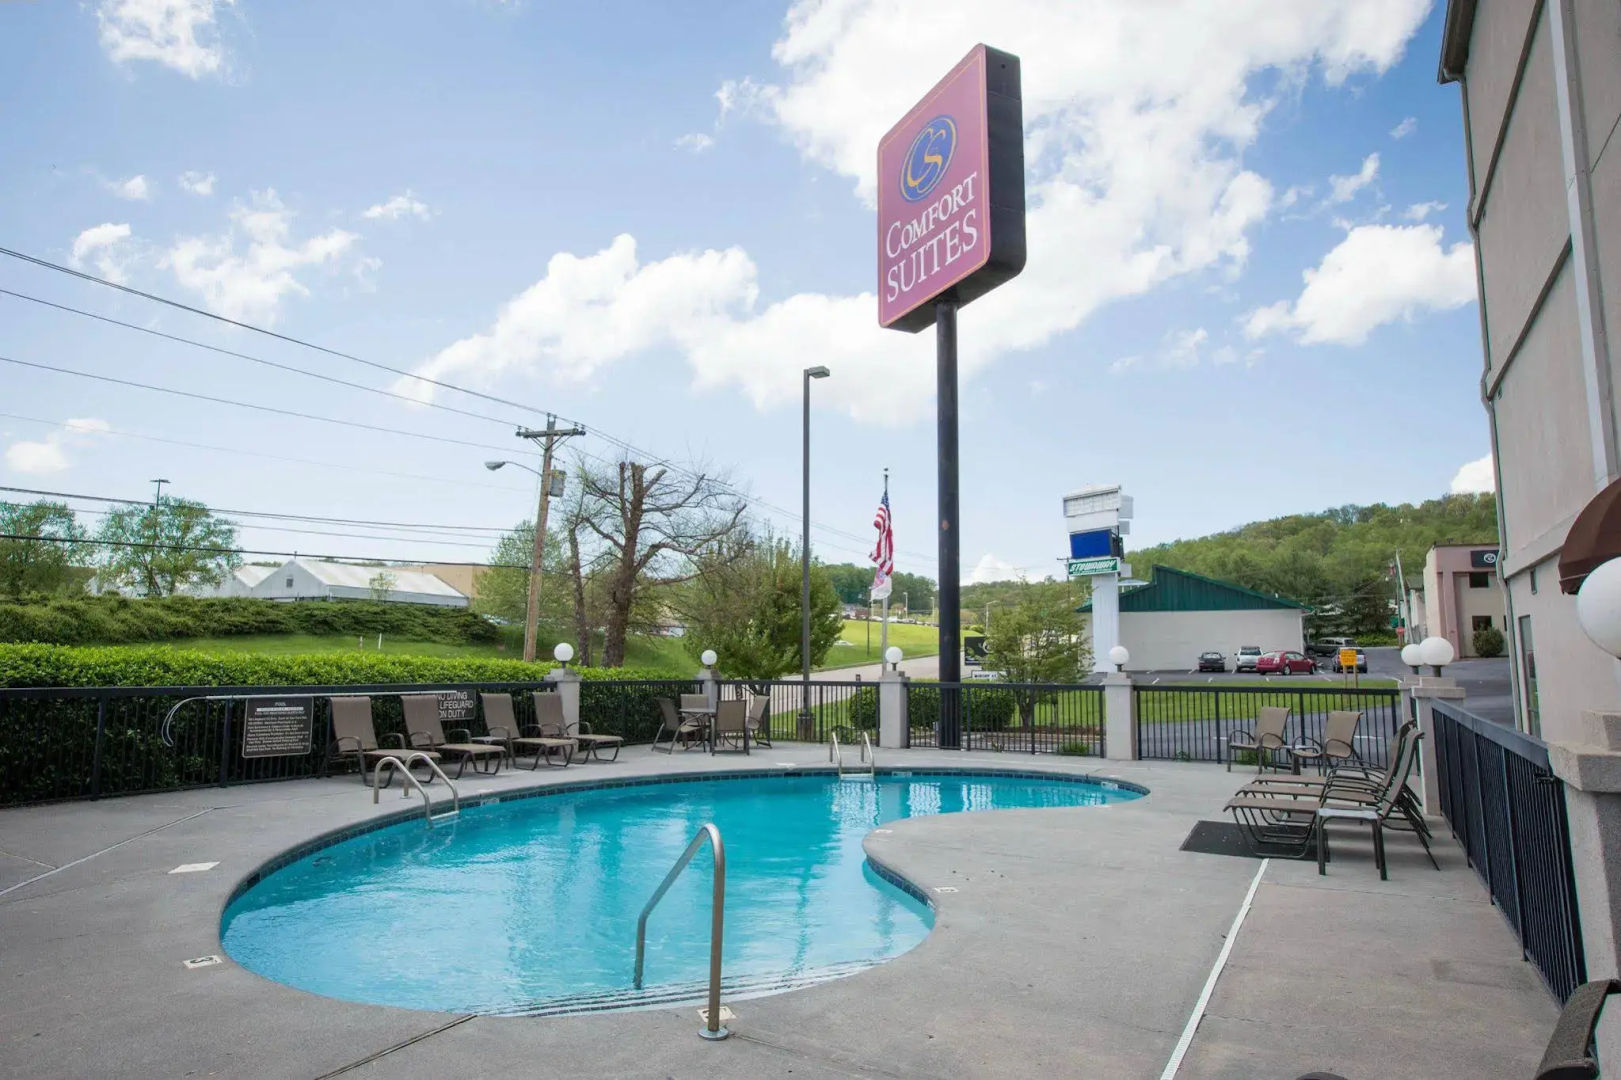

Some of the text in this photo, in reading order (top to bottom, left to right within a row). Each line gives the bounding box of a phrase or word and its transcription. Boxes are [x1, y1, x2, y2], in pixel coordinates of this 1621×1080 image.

[886, 171, 977, 258] COMFORT
[887, 208, 978, 302] SUITES
[447, 691, 468, 700] DIVING
[440, 700, 474, 709] LIFEGUARD
[448, 709, 466, 718] DUTY
